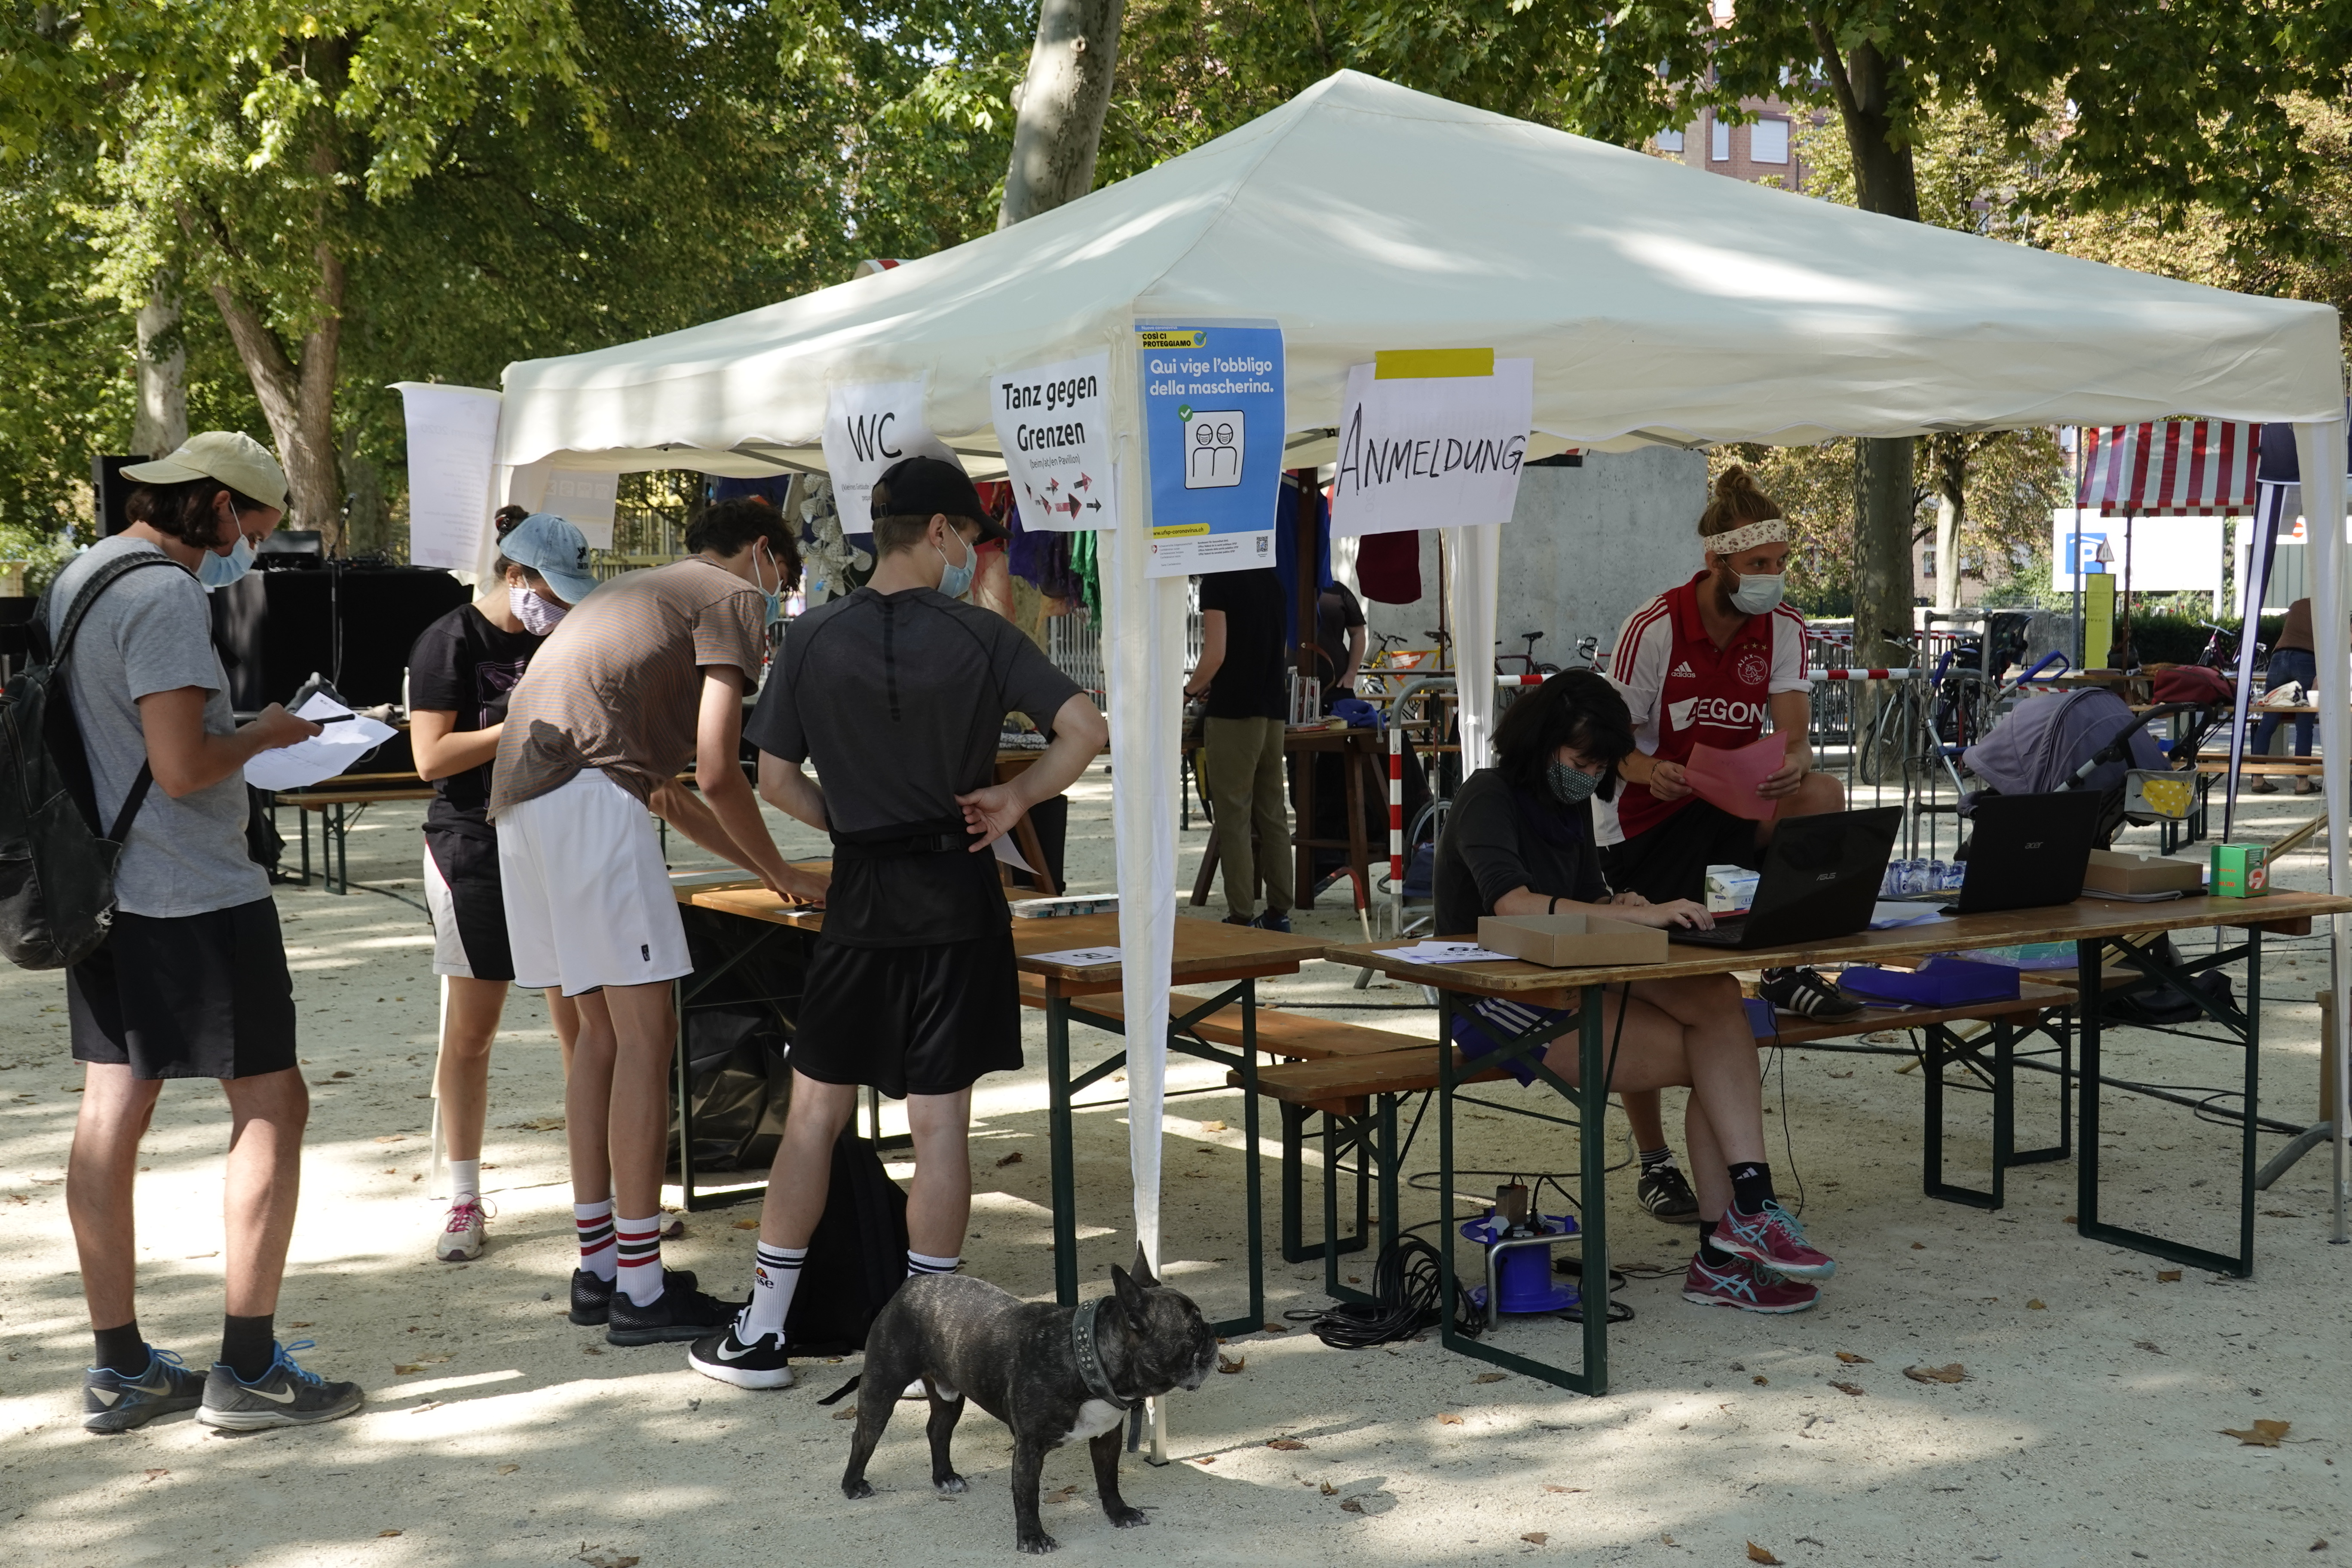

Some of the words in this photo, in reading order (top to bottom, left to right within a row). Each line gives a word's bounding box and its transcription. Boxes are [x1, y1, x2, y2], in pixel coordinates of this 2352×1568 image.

[1150, 358, 1176, 374] Qui
[1179, 358, 1210, 377] vige
[1213, 357, 1272, 376] l'obbligo
[1002, 383, 1041, 410] Tanz
[1046, 375, 1097, 411] gegen
[1150, 380, 1185, 395] della
[1189, 378, 1274, 395] mascherina.
[848, 412, 902, 462] WC
[1017, 423, 1085, 451] Grenzen
[1337, 402, 1525, 497] ANMELDUNG
[1058, 453, 1081, 465] Pavillon)
[2080, 542, 2098, 572] P
[1738, 654, 1753, 668] AJAX
[1685, 697, 1767, 723] AEGON
[1816, 872, 1836, 881] ASUS
